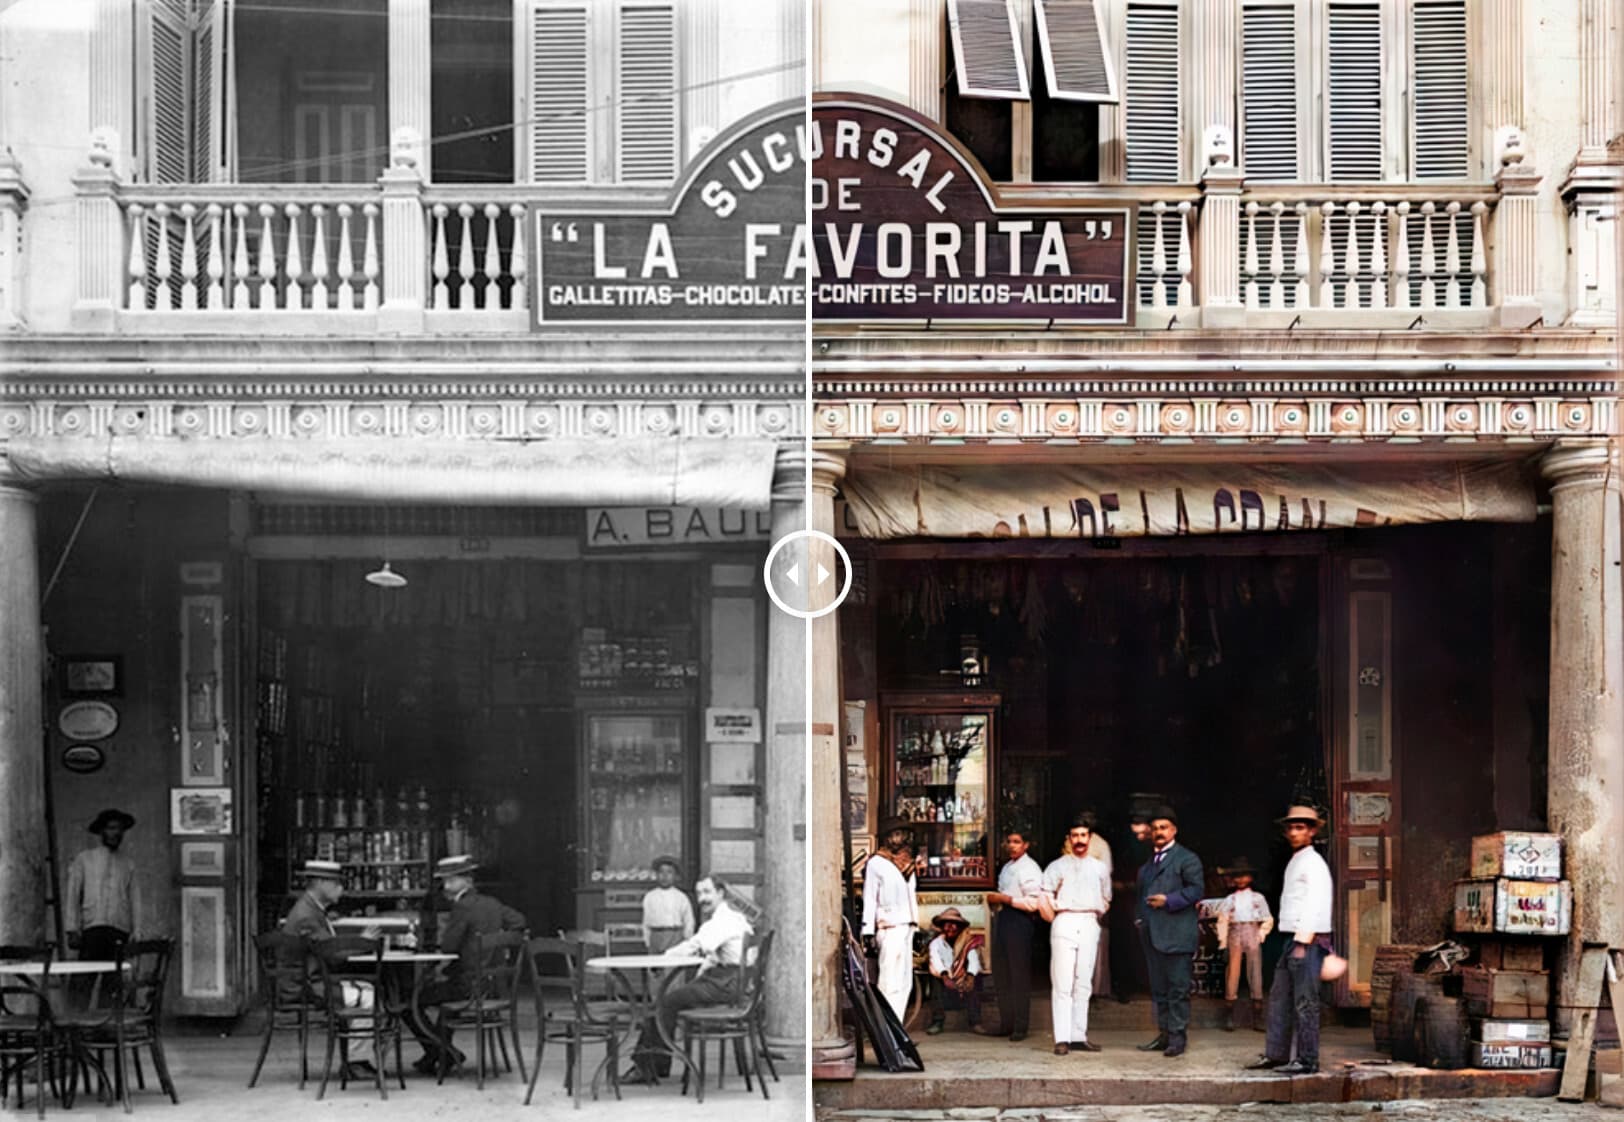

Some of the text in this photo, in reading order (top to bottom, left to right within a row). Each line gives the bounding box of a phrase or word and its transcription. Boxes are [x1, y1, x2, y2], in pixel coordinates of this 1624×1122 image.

[701, 119, 954, 217] SUCURSAL
[806, 178, 861, 210] DE
[592, 510, 629, 541] A.
